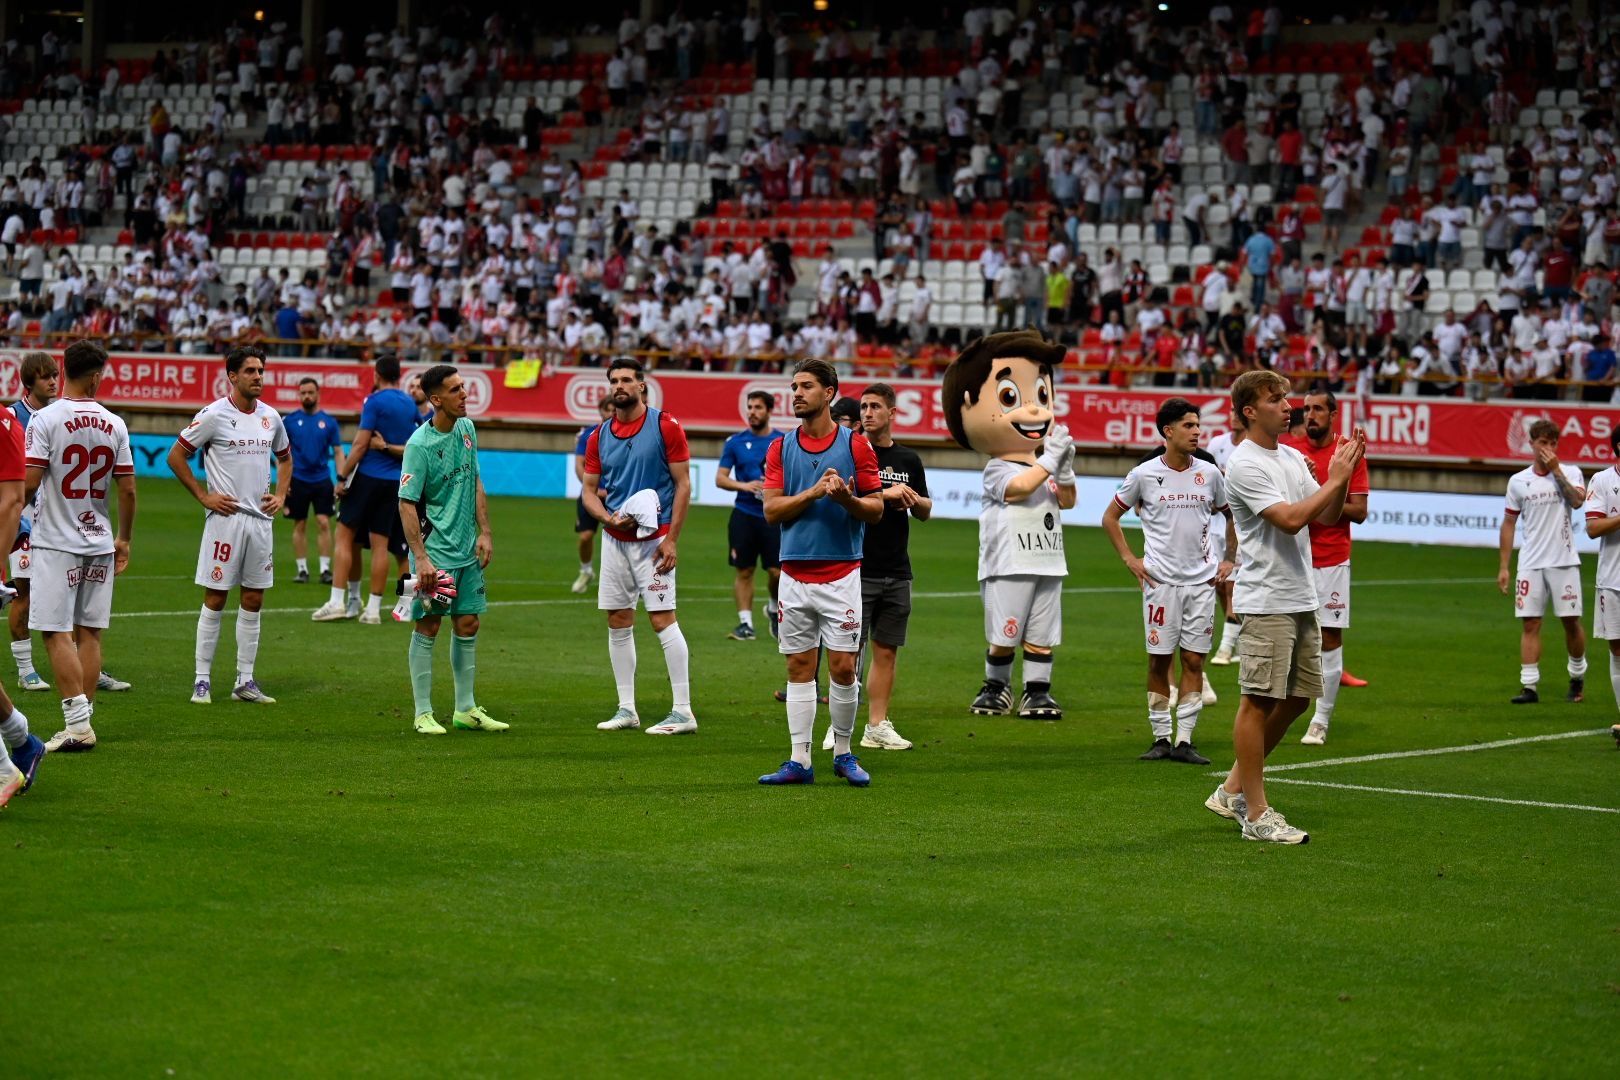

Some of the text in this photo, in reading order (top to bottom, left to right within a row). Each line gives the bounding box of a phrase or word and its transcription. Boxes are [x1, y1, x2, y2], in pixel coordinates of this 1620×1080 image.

[102, 362, 196, 386] ASPIRE
[112, 386, 183, 400] ACADEMY
[1083, 394, 1156, 414] Frutas
[64, 415, 114, 436] RADOJA
[61, 443, 115, 500] 22
[1159, 493, 1206, 502] ASPIRE
[1382, 511, 1405, 524] DE
[1407, 513, 1430, 526] LO
[1433, 513, 1500, 530] SENCILL
[213, 541, 232, 563] 19
[1148, 604, 1165, 626] 14
